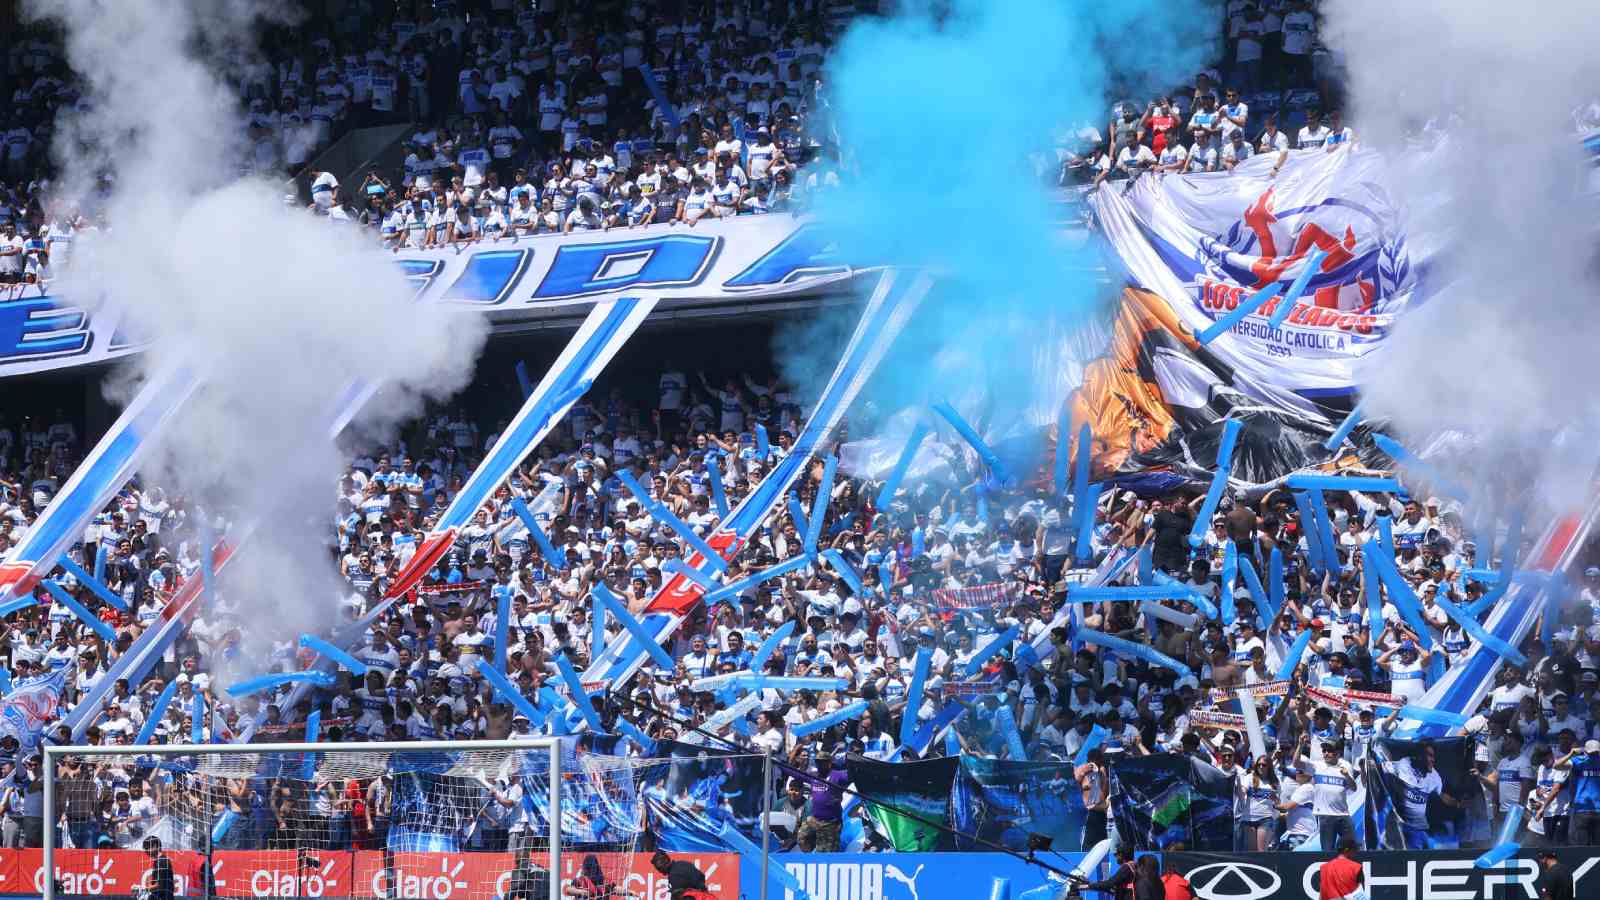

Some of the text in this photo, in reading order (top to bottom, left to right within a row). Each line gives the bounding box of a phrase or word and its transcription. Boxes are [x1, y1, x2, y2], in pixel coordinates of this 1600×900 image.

[1203, 281, 1245, 311] LOS
[1286, 331, 1346, 351] CATOLICA
[251, 869, 324, 897] Claro
